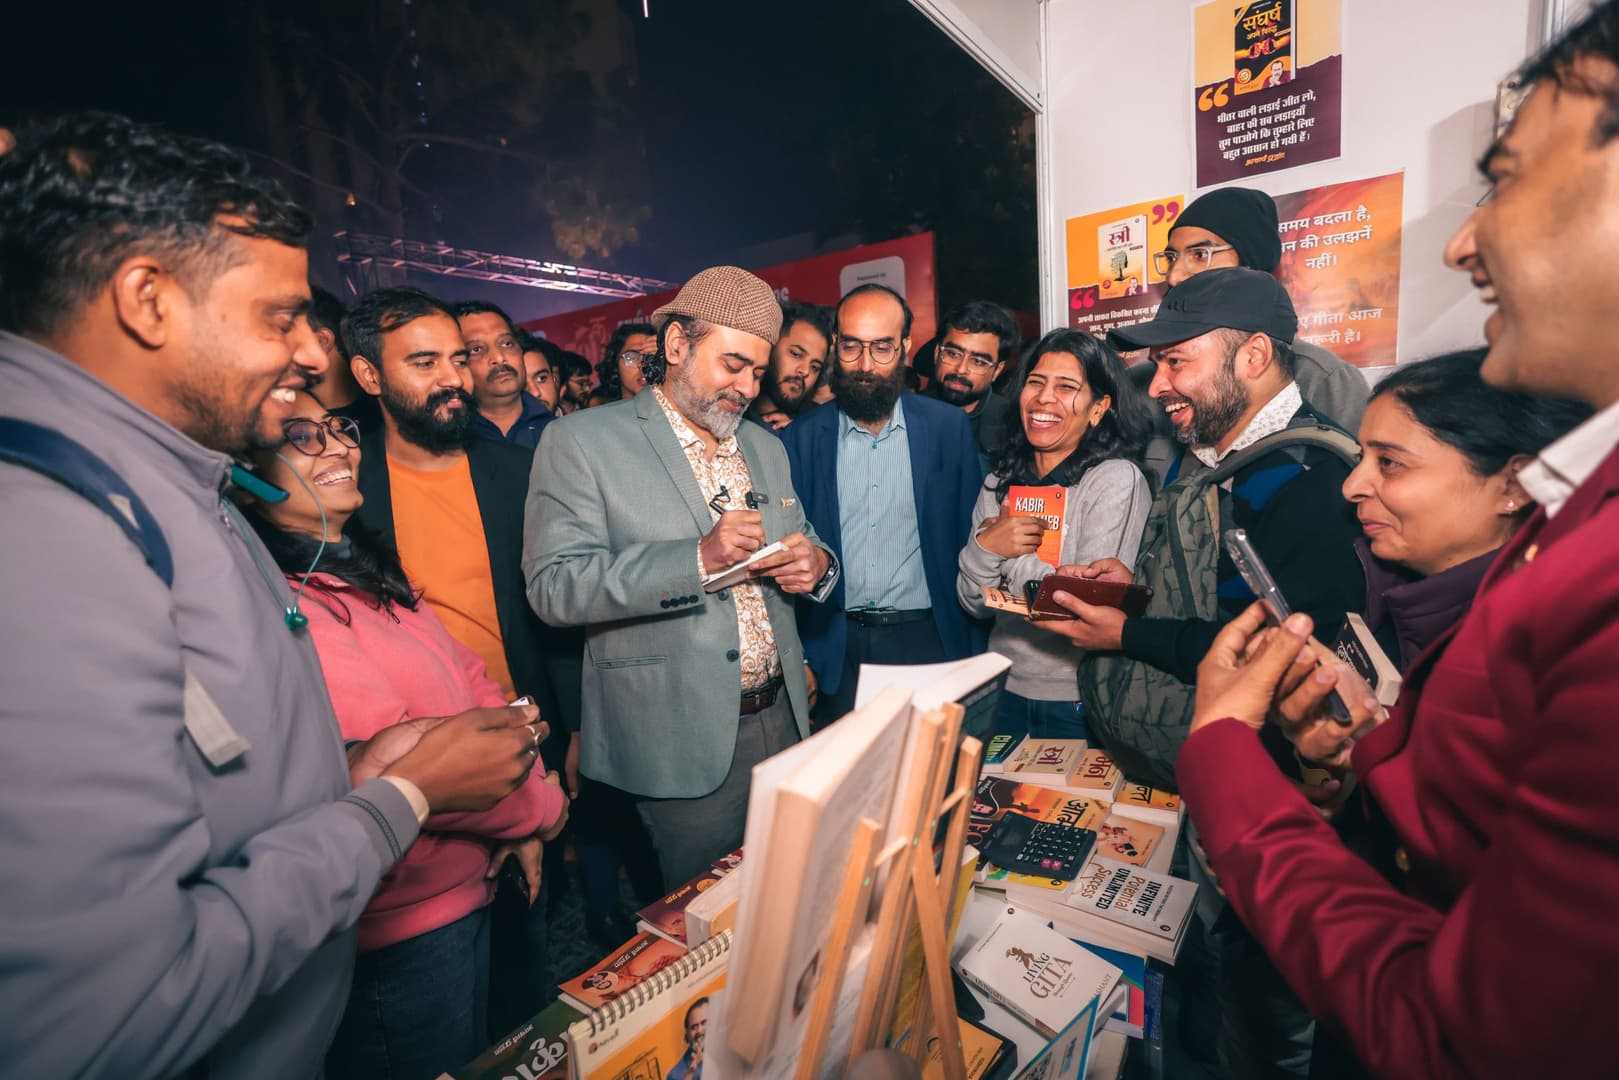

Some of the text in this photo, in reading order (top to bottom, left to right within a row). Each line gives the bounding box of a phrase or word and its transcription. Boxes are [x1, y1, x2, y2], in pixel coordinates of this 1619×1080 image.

[1242, 1, 1282, 31] संघर्ष
[1217, 111, 1236, 123] भीतर
[1238, 105, 1257, 118] वाली
[1282, 95, 1300, 108] जीत
[1219, 138, 1231, 151] तुम
[1260, 128, 1271, 139] कि
[1297, 118, 1315, 129] लिए
[1227, 122, 1245, 133] बाहर
[1247, 118, 1257, 129] की
[1260, 116, 1272, 126] सब
[1223, 149, 1240, 161] बहुत
[1242, 143, 1269, 155] आसान
[1270, 137, 1280, 149] हो
[1281, 134, 1297, 146] गयी
[1278, 205, 1371, 233] समय बदला है,
[1108, 226, 1131, 246] स्त्री
[1300, 235, 1318, 249] की
[1324, 225, 1373, 244] उलझनें
[1305, 252, 1337, 269] नहीं।
[1312, 310, 1343, 325] गीता
[1348, 308, 1383, 320] आज
[1344, 328, 1361, 344] है।
[1015, 497, 1045, 512] KABIR
[1036, 745, 1066, 764] स्त्री
[1081, 868, 1112, 899] Success
[1095, 868, 1131, 910] UNLIMITED
[1113, 876, 1146, 912] Potential
[1132, 881, 1162, 917] INFINITE
[1023, 952, 1050, 984] LIVING
[1030, 956, 1073, 1000] GITA
